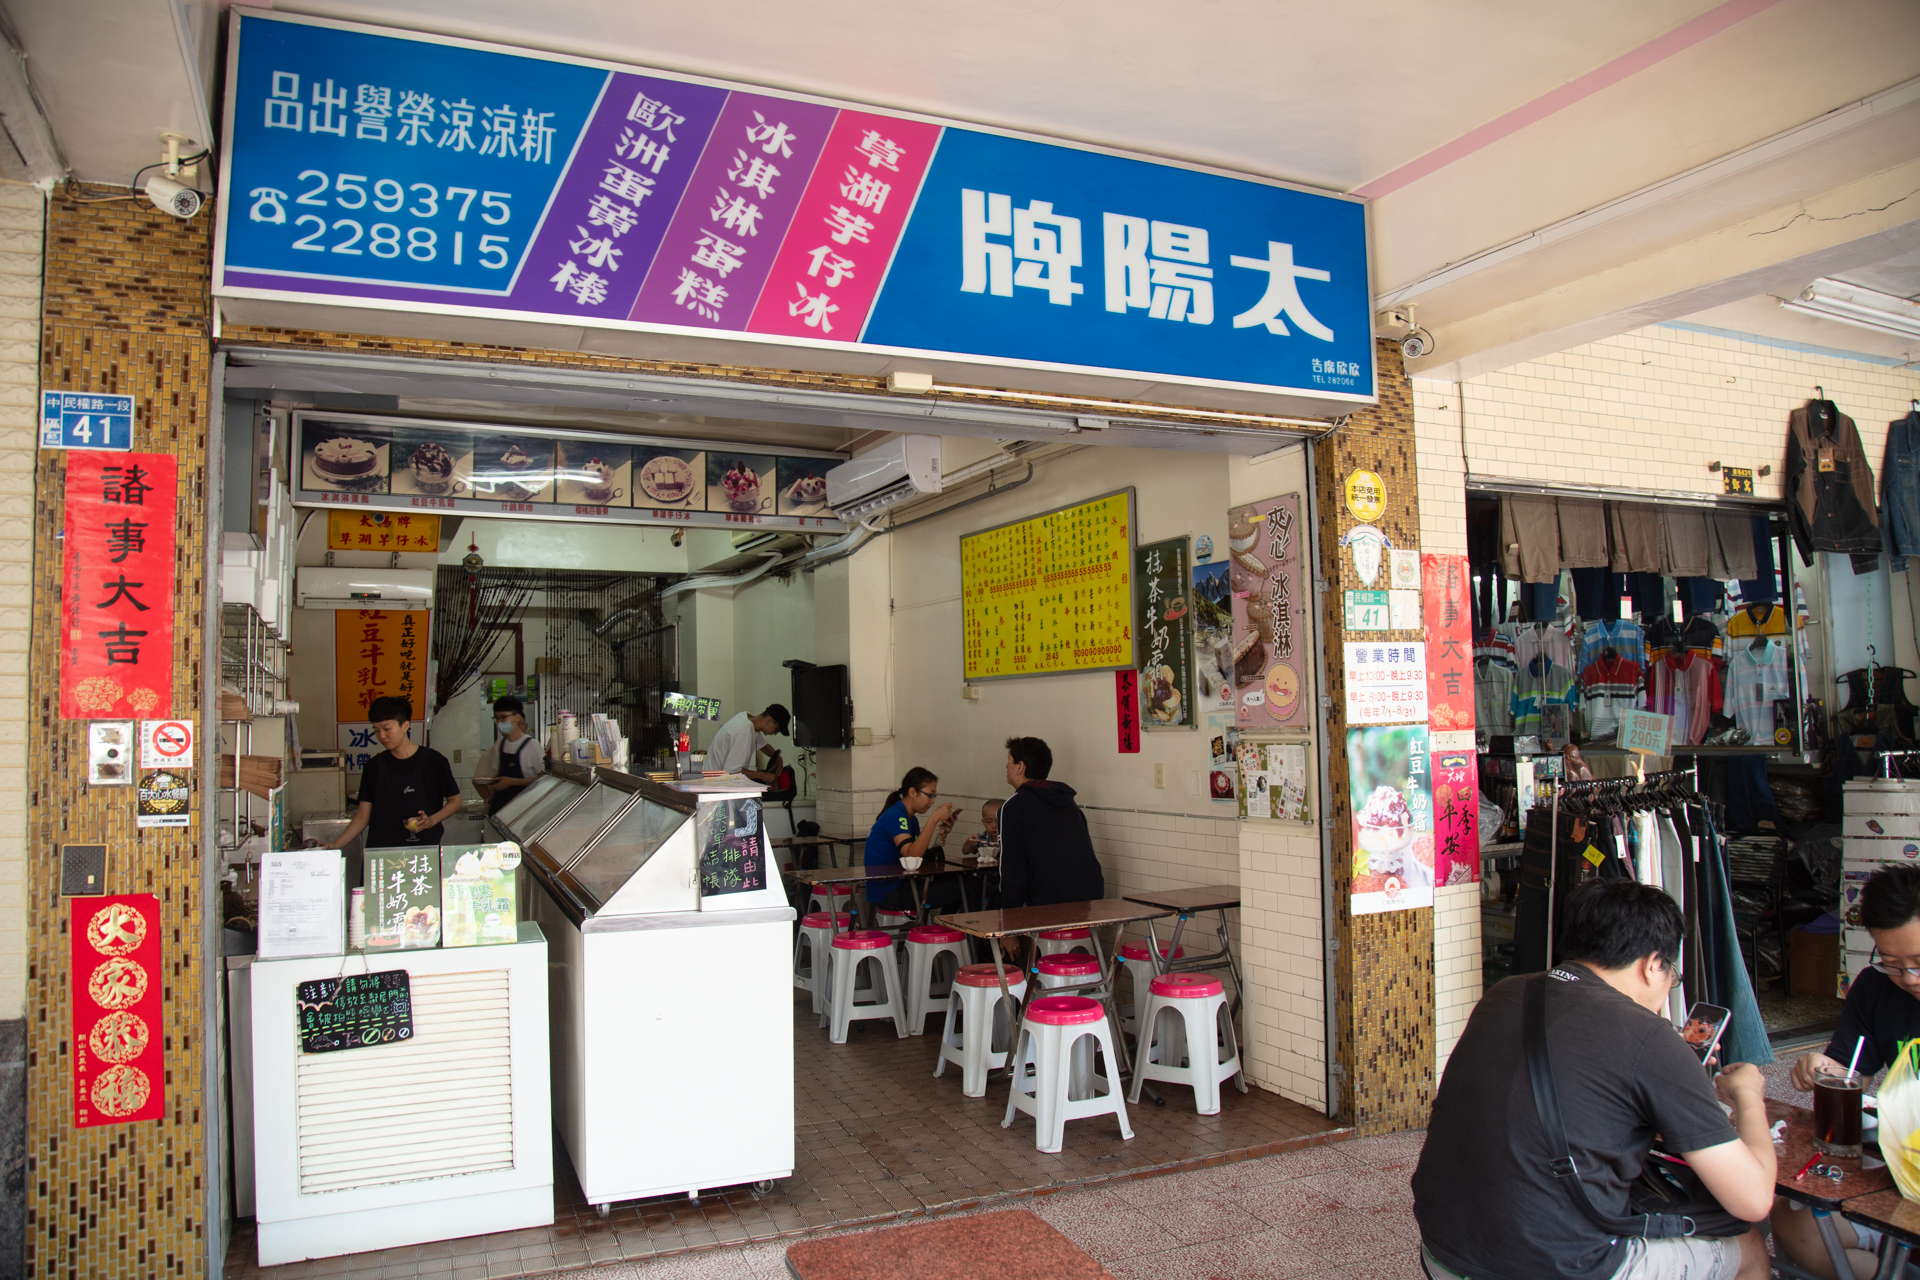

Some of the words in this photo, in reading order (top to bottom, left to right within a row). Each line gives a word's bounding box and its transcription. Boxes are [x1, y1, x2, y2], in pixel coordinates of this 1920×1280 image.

[296, 169, 512, 225] 259375
[550, 91, 687, 306] 歐洲蛋黃冰棒
[671, 109, 797, 323] 冰淇淋蛋糕
[291, 214, 510, 270] 228815
[788, 128, 906, 333] 草湖芋仔冰
[1312, 375, 1326, 384] TEL
[64, 397, 130, 412] 民權路一段
[73, 415, 111, 444] 41
[411, 497, 455, 508] 紅豆牛乳霜
[96, 464, 154, 666] 諸事大吉
[1270, 571, 1293, 659] 冰淇淋
[1362, 608, 1379, 626] 41
[1437, 563, 1463, 696] 諸事大吉
[1356, 647, 1415, 663] 營業時間
[1630, 729, 1662, 748] 290元
[1633, 714, 1663, 734] 特價
[139, 788, 188, 801] 百大心水餐廳
[1405, 736, 1428, 833] 紅豆牛奶霜
[408, 854, 433, 896] 抹茶
[722, 848, 742, 888] 排隊
[742, 836, 760, 889] 請由此
